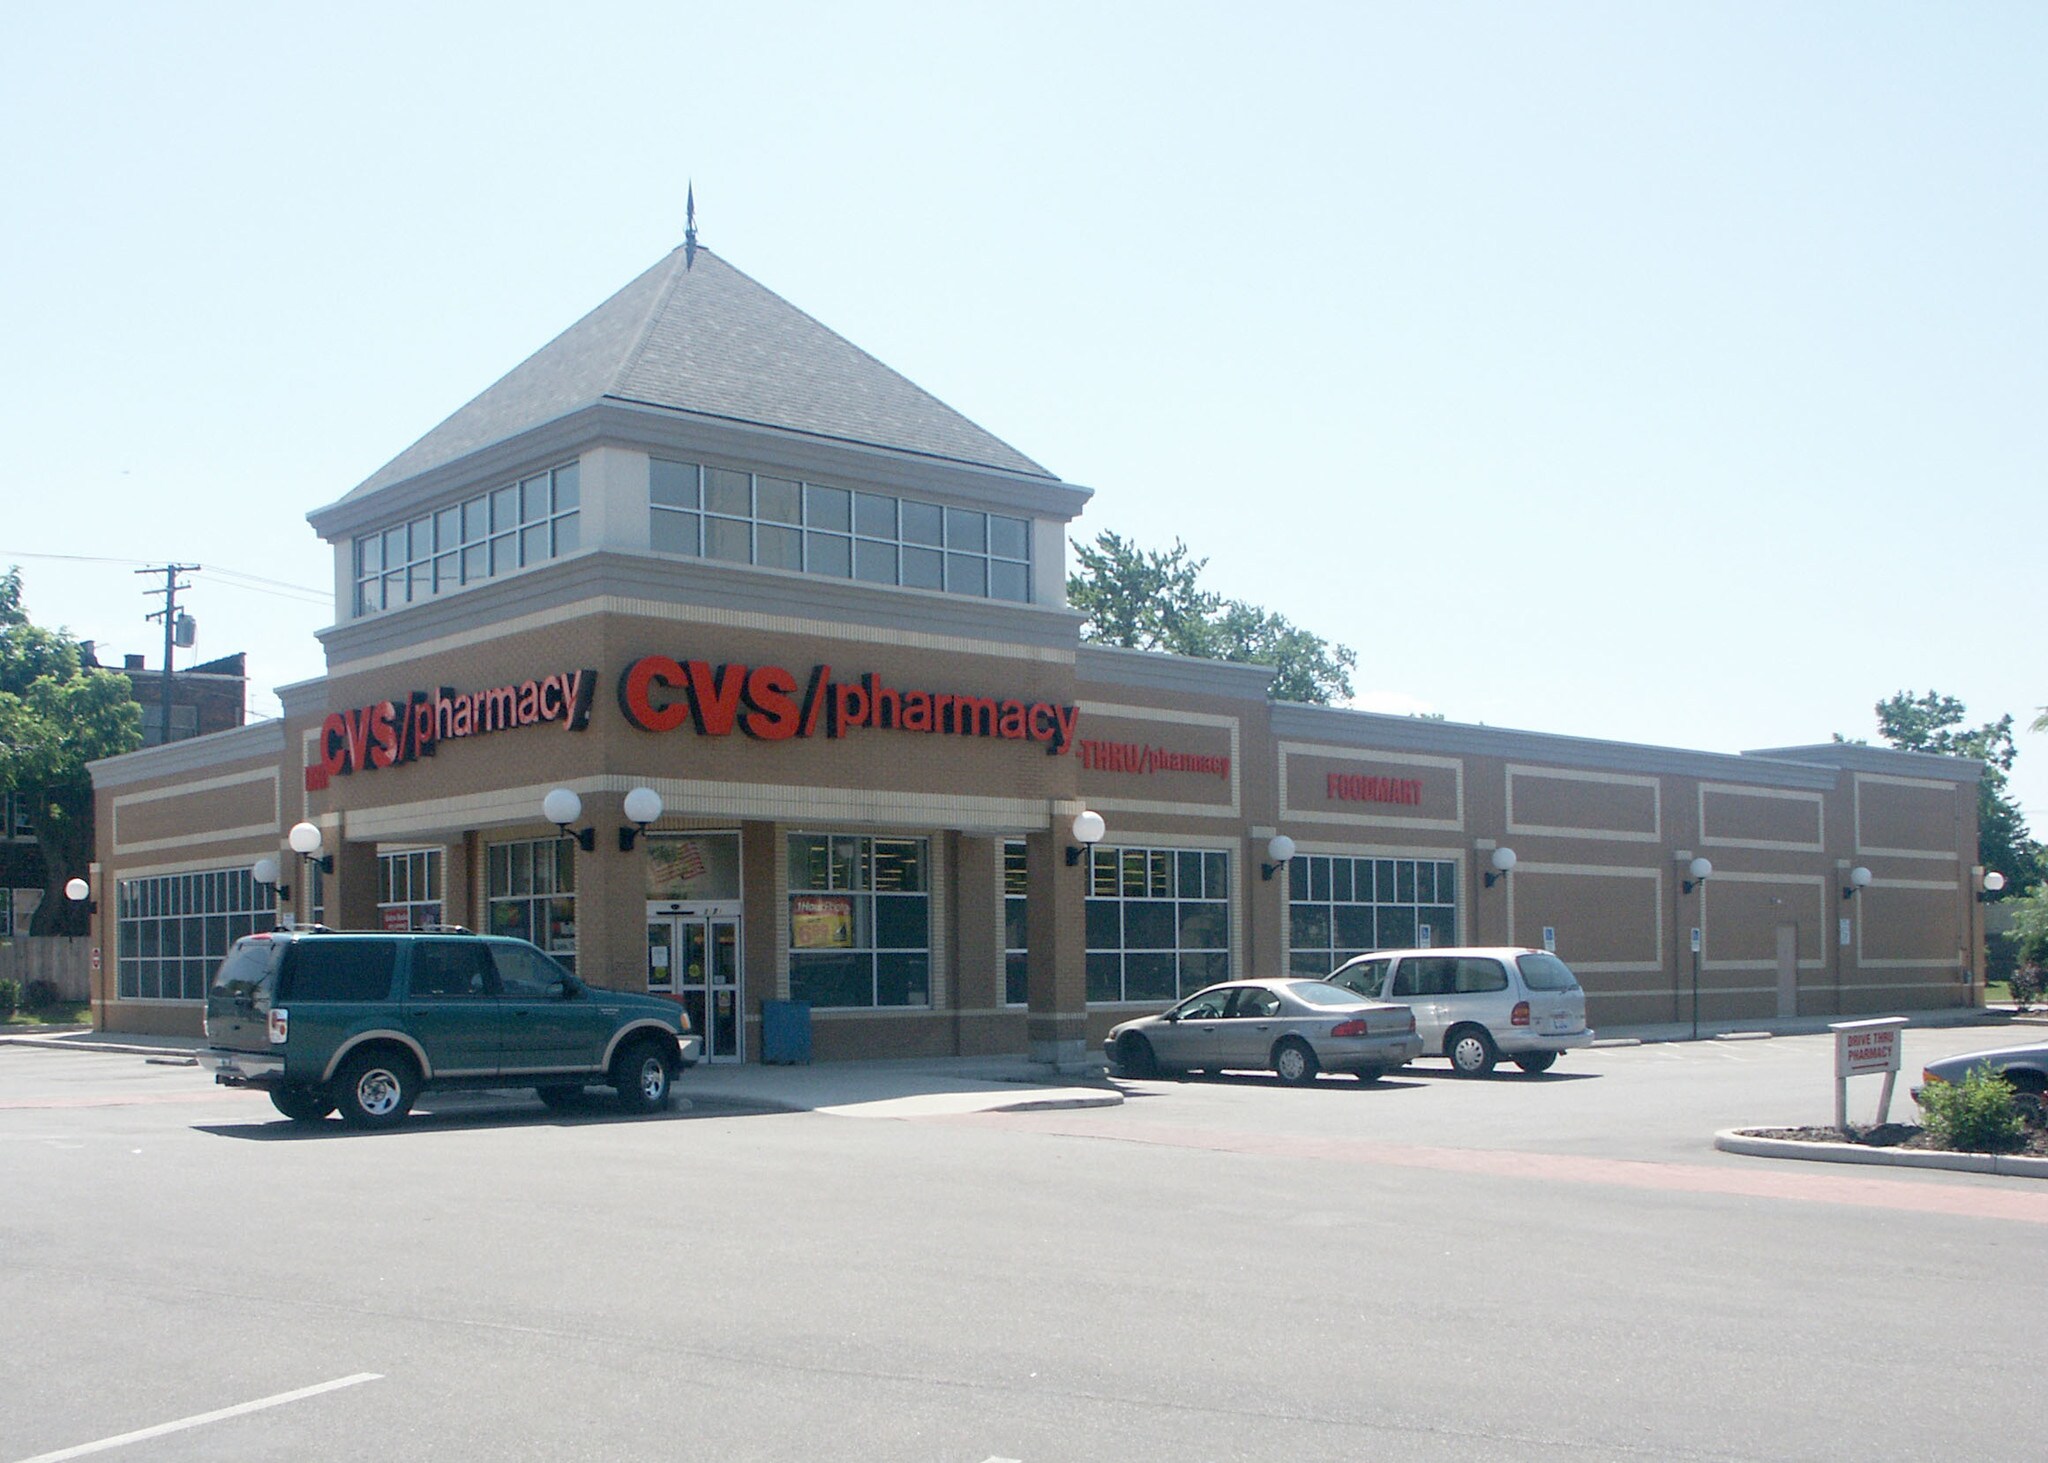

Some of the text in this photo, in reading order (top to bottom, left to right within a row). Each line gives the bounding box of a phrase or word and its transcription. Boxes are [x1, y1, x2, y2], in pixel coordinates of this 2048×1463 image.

[618, 655, 1080, 756] CVS/pharmacy
[320, 669, 597, 776] CVS/pharmacy
[1327, 773, 1424, 806] FOODMART
[1847, 1030, 1895, 1048] DRIVE THRU
[1847, 1045, 1893, 1061] PHARMACY
